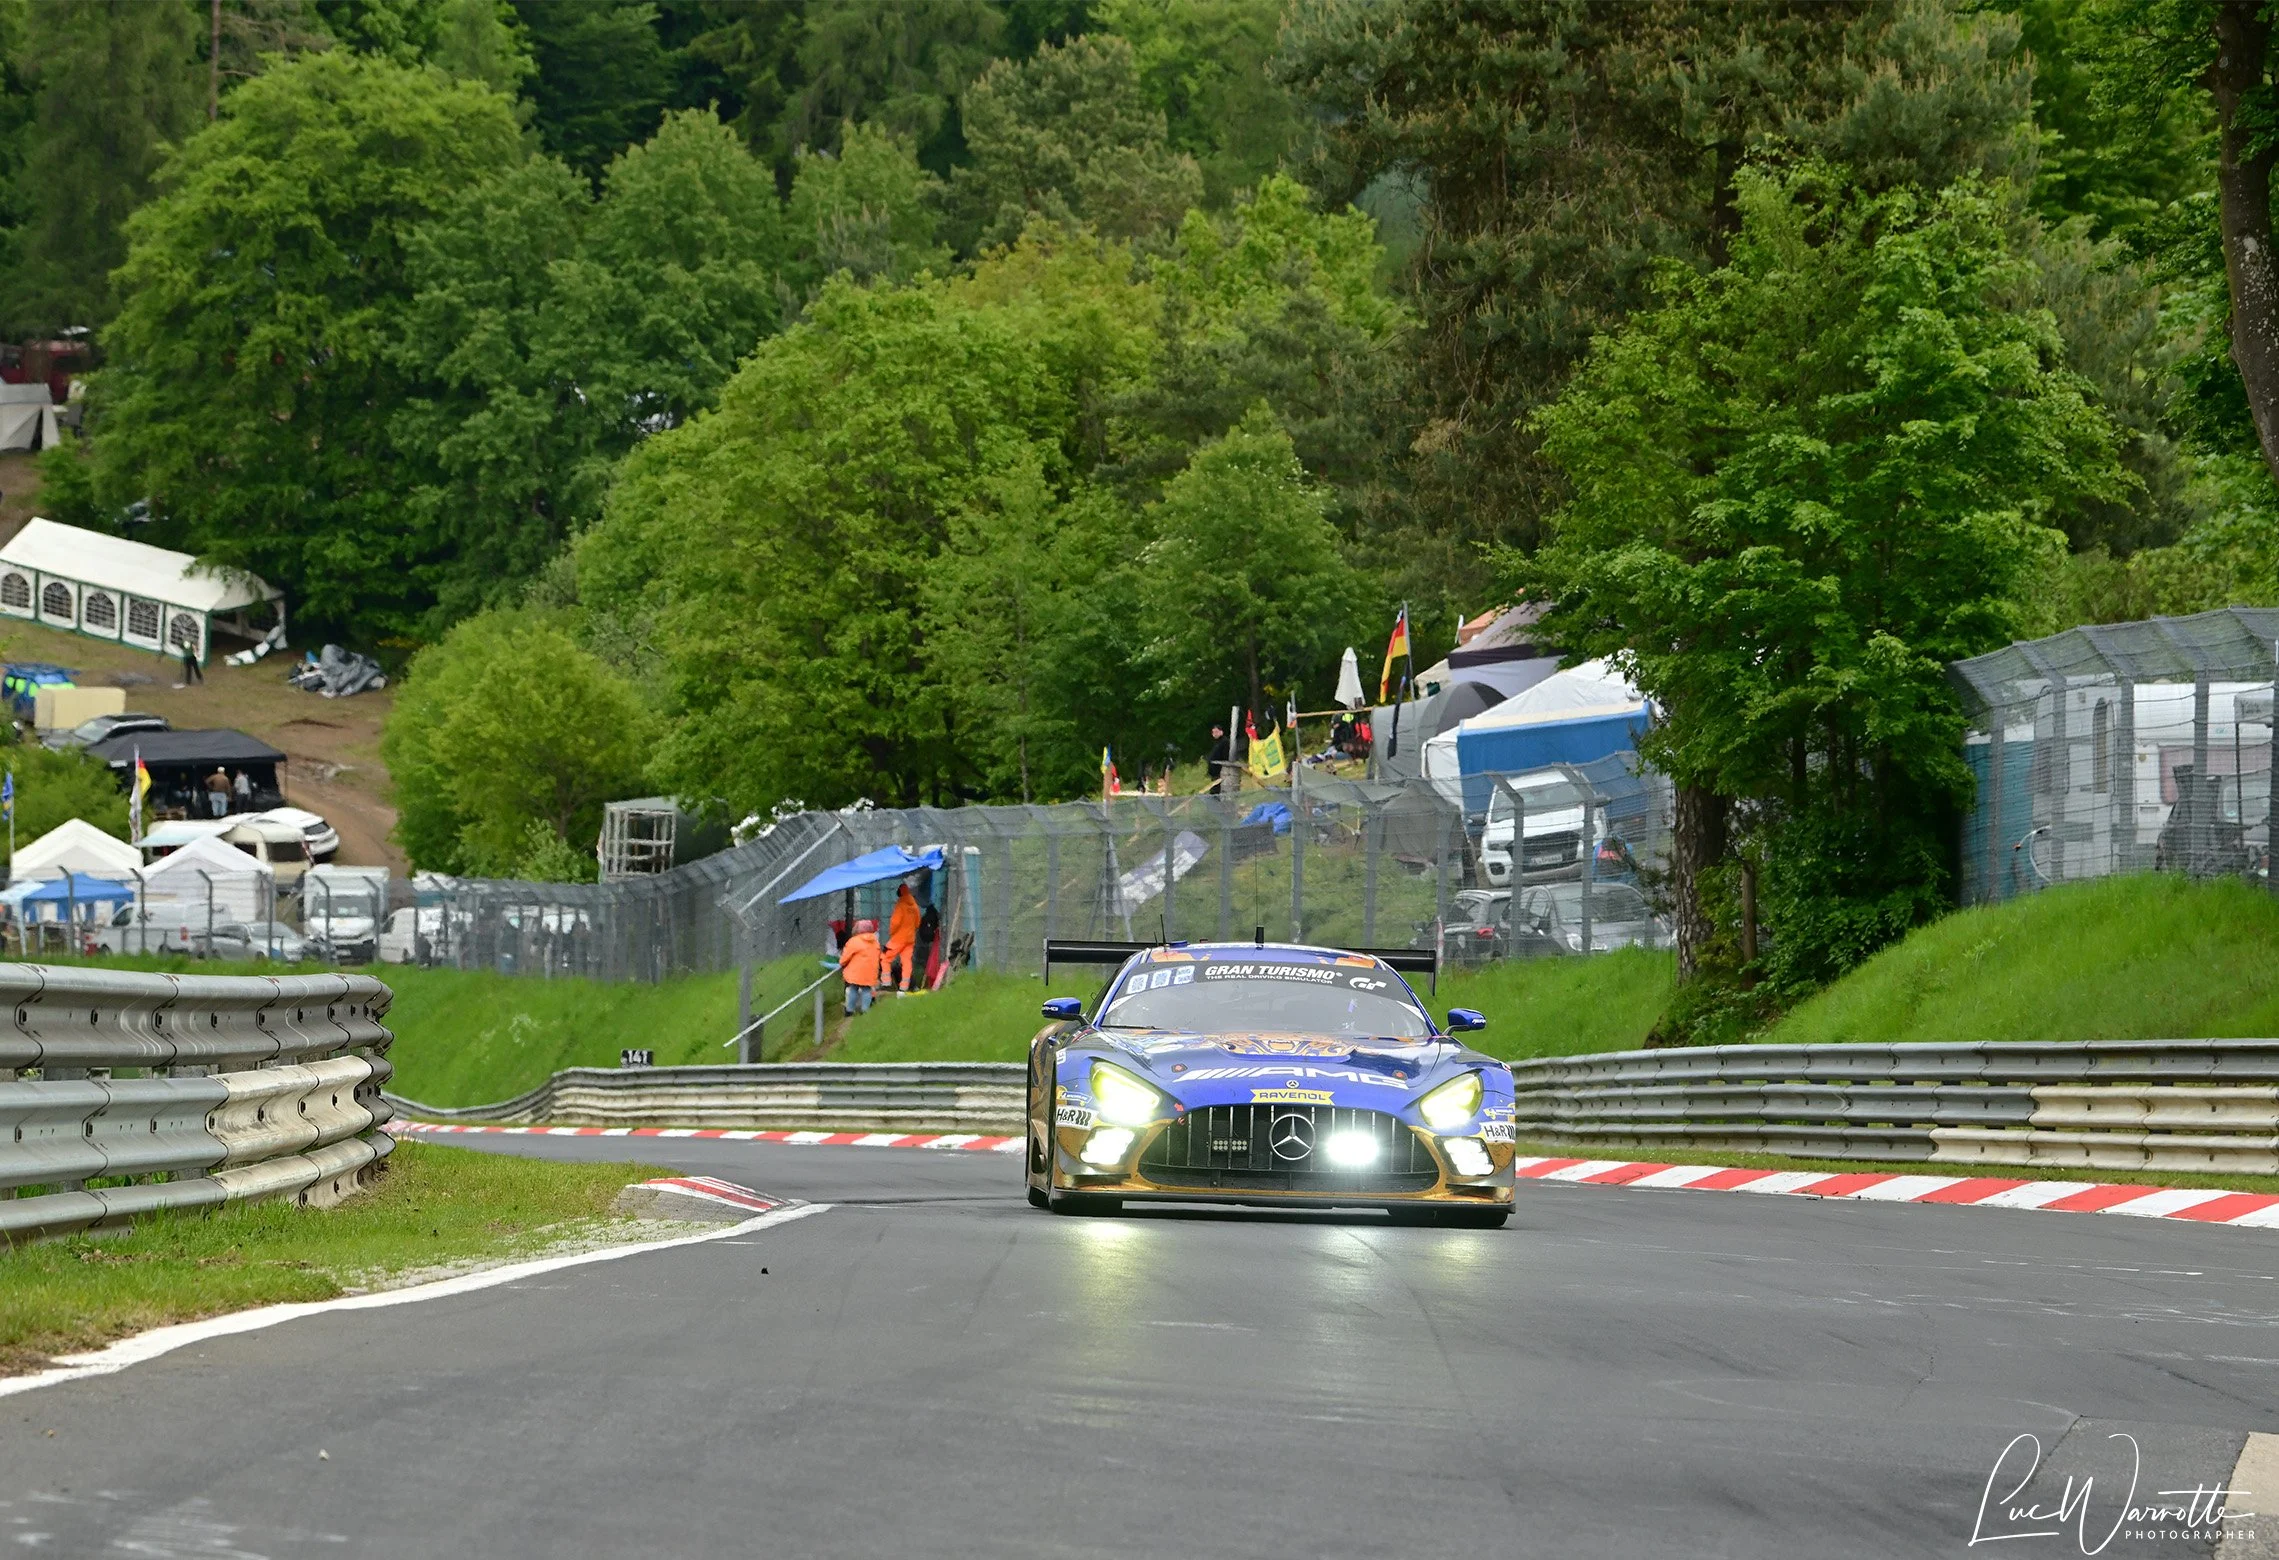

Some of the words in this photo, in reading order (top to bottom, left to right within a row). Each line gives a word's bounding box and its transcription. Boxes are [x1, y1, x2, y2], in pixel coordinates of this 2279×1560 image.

[1205, 965, 1256, 976] GRAN
[1258, 965, 1336, 980] TURISMO
[1284, 976, 1333, 985] SIMULATOR
[1259, 1091, 1326, 1101] RAVENOL
[1057, 1108, 1076, 1122] H&R
[1484, 1125, 1508, 1138] H&R
